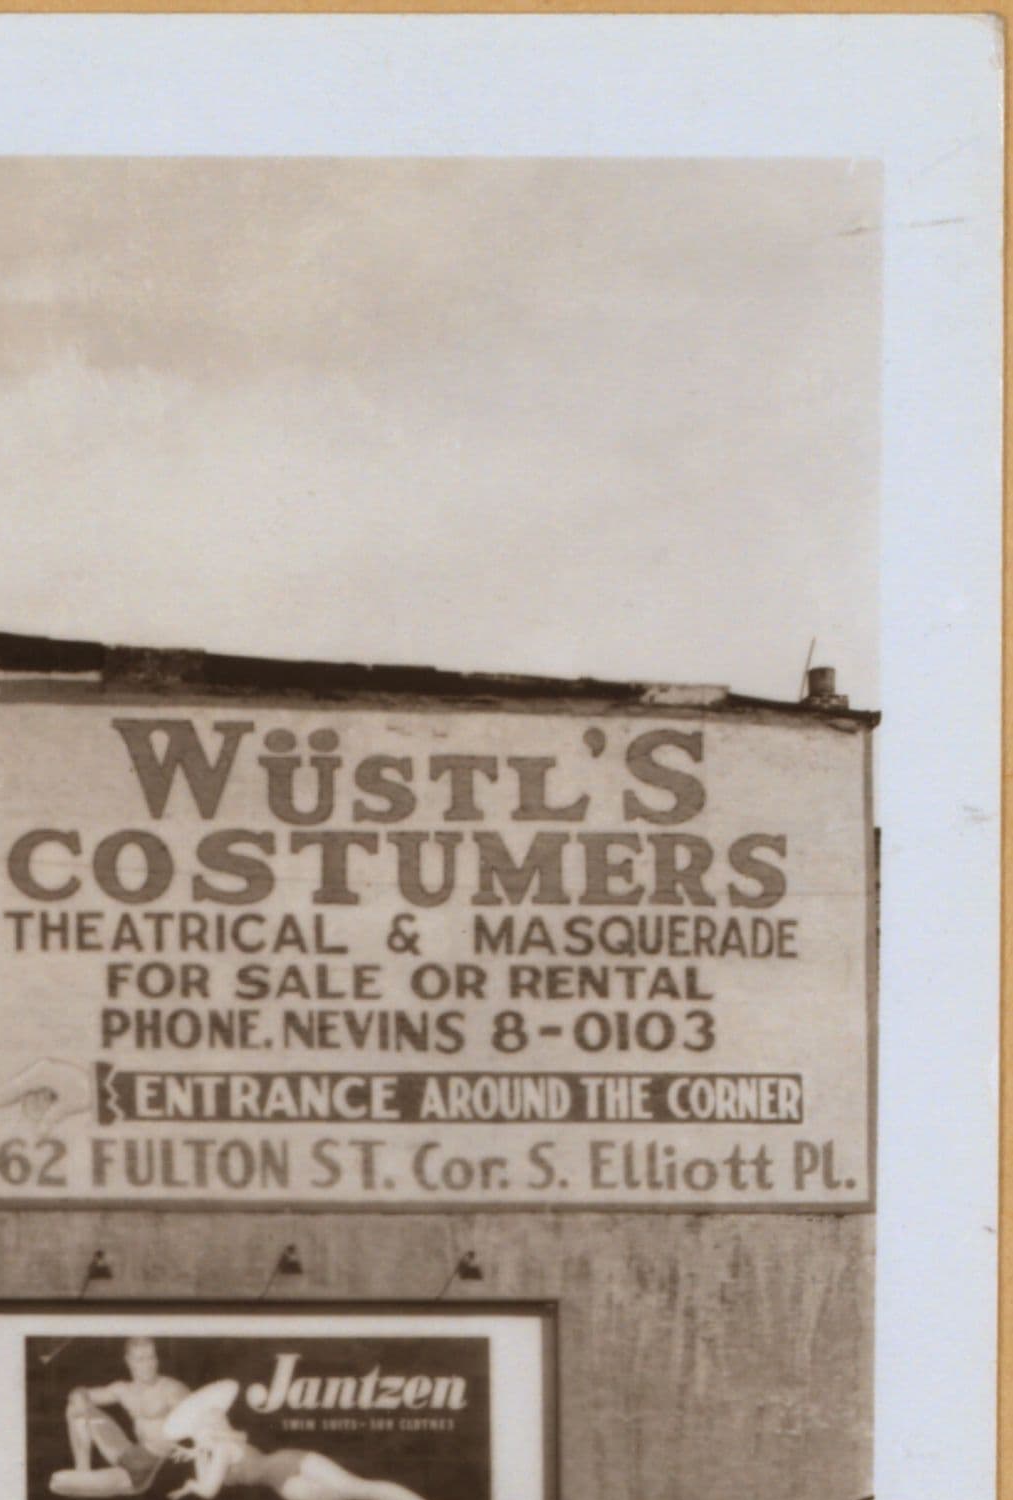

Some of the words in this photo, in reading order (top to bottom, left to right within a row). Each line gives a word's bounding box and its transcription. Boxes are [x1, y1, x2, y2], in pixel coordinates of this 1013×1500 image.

[5, 828, 787, 909] COSTUMERS
[3, 910, 349, 956] THEATRICAL
[386, 912, 421, 957] &
[473, 914, 798, 959] MASQUERADE
[106, 961, 210, 999] FOR
[235, 963, 382, 1002] SALE
[410, 962, 488, 1001] OR
[508, 964, 713, 1001] RENTAL
[101, 1007, 273, 1050] PHONE.
[283, 1010, 466, 1055] NEVINS
[490, 1009, 716, 1055] 8-0103
[134, 1075, 400, 1119] ENTRANCE
[420, 1076, 571, 1120] AROUND
[580, 1076, 653, 1120] THE
[667, 1077, 801, 1121] CORNER
[91, 1138, 289, 1190] FULTON
[311, 1137, 396, 1191] ST.
[411, 1140, 511, 1192] Cor.
[527, 1140, 569, 1191] S.
[589, 1140, 774, 1192] Elliott
[793, 1140, 857, 1191] Pl.
[246, 1353, 467, 1414] Jantzen
